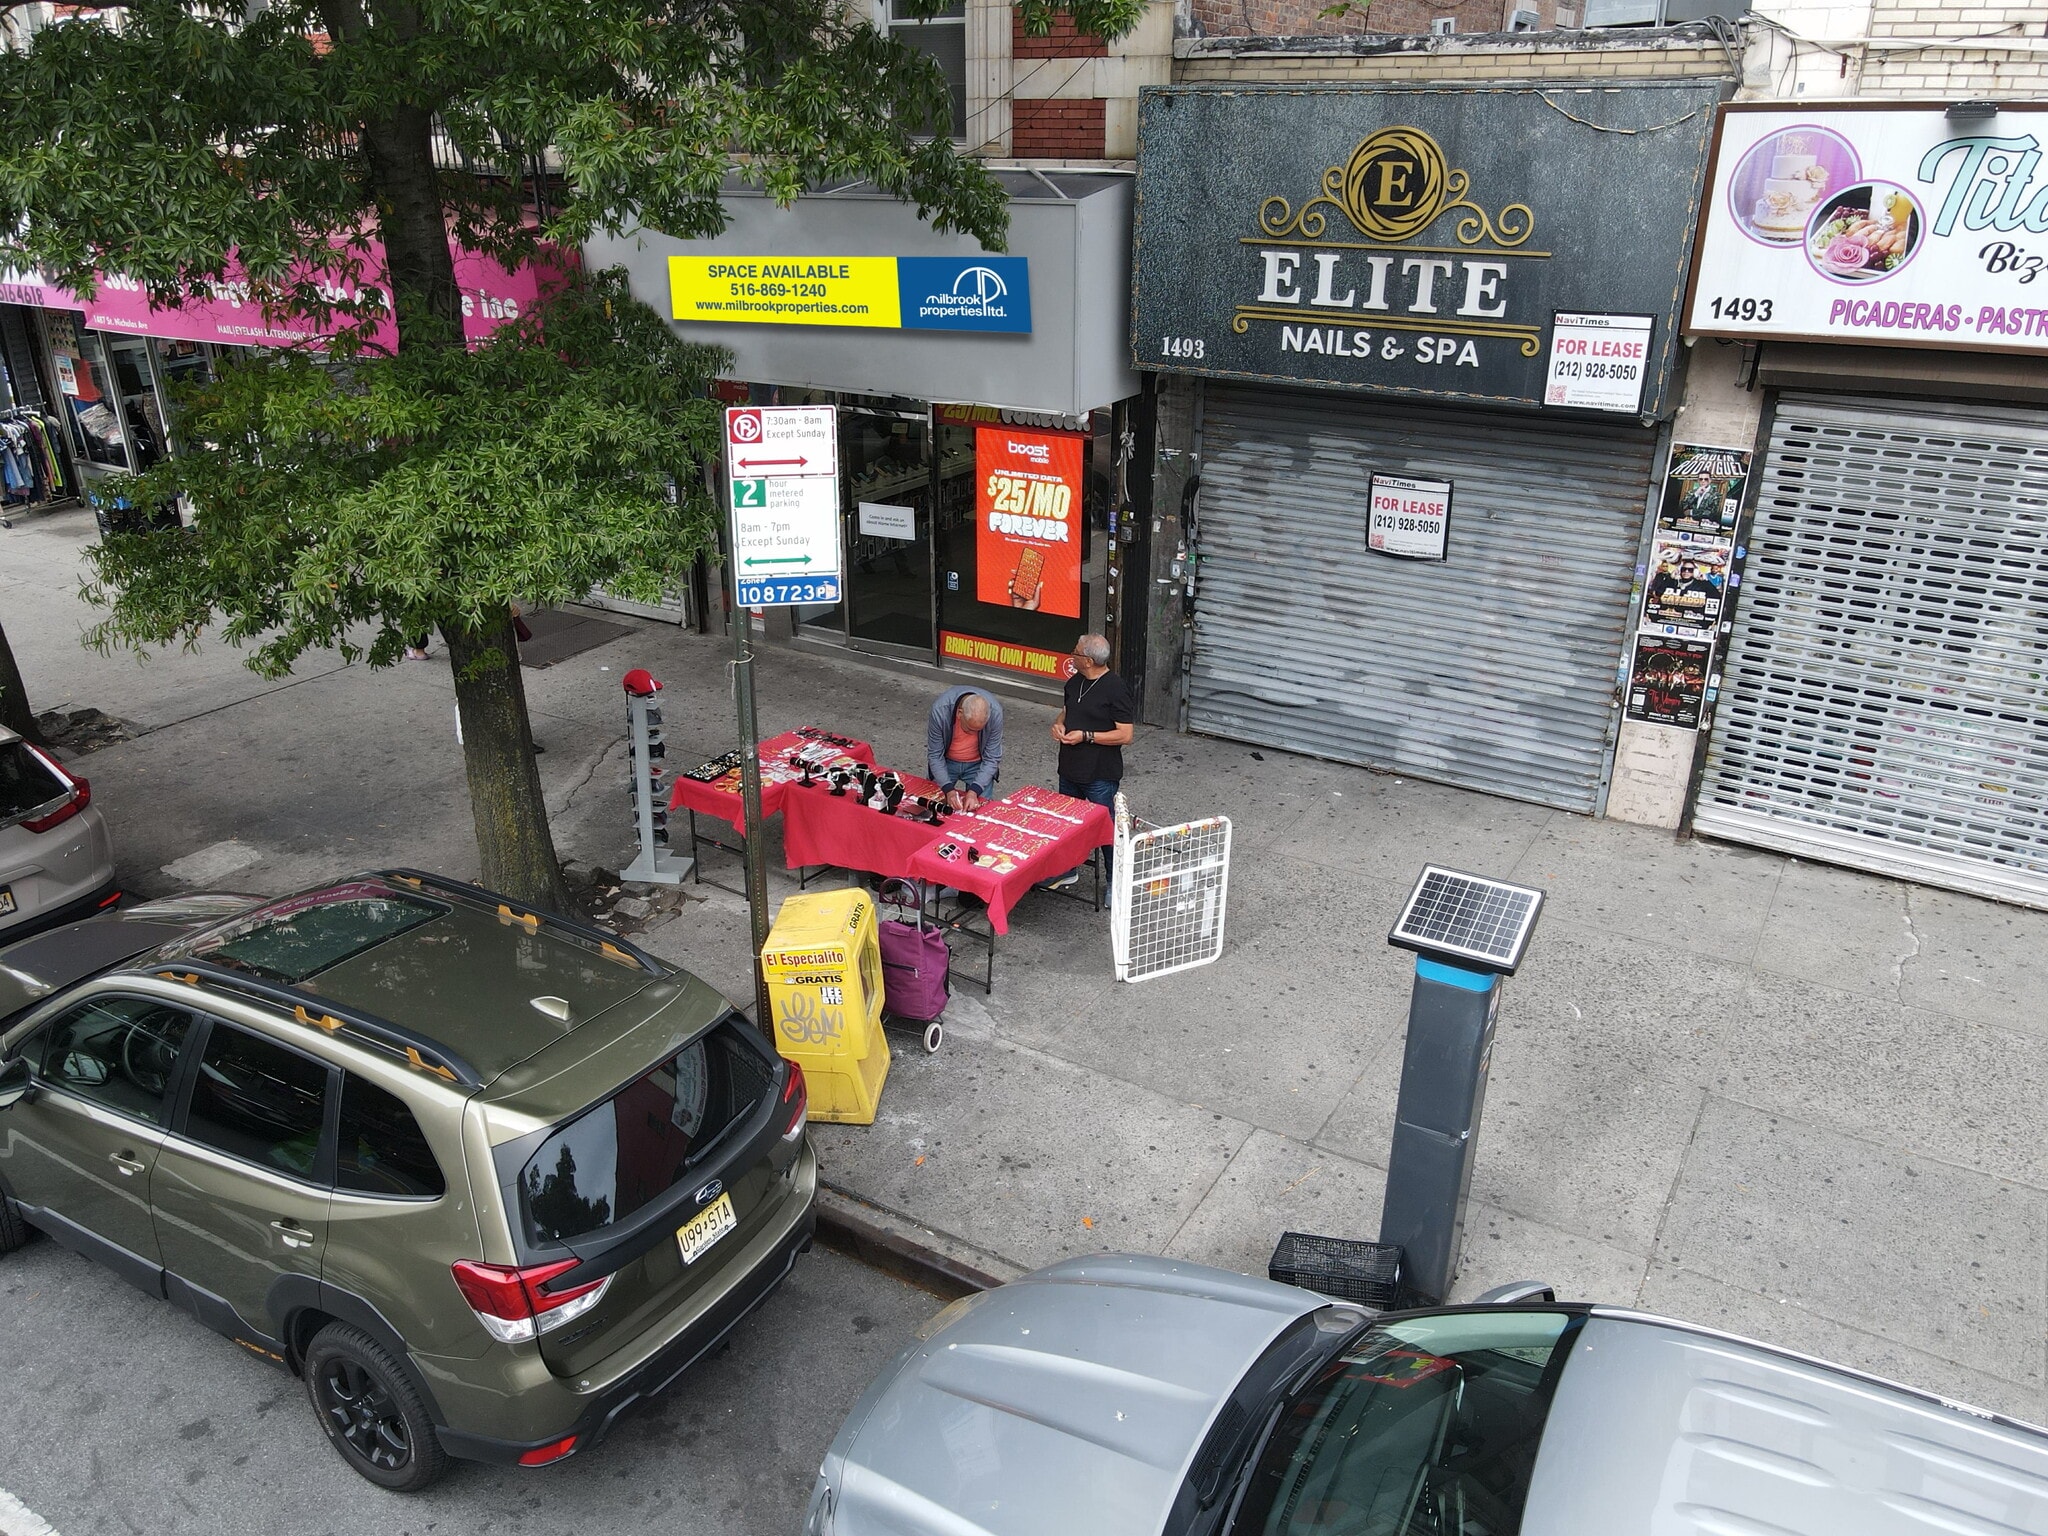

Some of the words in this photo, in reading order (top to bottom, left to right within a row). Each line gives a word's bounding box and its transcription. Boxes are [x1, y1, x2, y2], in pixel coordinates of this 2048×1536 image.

[708, 264, 758, 278] SPACE
[762, 265, 850, 279] AVAILABLE
[1978, 241, 2048, 285] Biz
[730, 283, 826, 298] 516-869-1240
[1257, 250, 1508, 319] ELITE
[480, 288, 518, 320] inc
[696, 300, 869, 314] www.milbrookproperties.com
[926, 294, 982, 305] milbrook
[920, 306, 982, 318] properties
[1710, 296, 1774, 322] 1493
[1829, 299, 1962, 332] PICADERAS
[114, 317, 138, 328] Nicholas
[1555, 316, 1610, 326] NaviTimes
[1161, 336, 1204, 359] 1493
[1281, 326, 1372, 358] NAILS
[1380, 336, 1404, 360] &
[1415, 336, 1480, 368] SPA
[1556, 338, 1588, 356] FOR
[1592, 340, 1643, 358] LEASE
[1554, 360, 1582, 381] (212)
[1585, 362, 1636, 380] 928-5050
[766, 416, 796, 426] 7:30am
[804, 416, 822, 425] 8am
[766, 430, 794, 440] Except
[796, 429, 826, 439] Sunday
[1008, 440, 1050, 458] boost
[1690, 453, 1734, 462] RAULIN
[994, 468, 1040, 480] UNLIMITED
[1040, 475, 1063, 483] DATA
[1669, 460, 1746, 476] RODRIGUEZ
[769, 480, 787, 488] hour
[1374, 477, 1416, 488] NaviTimes
[741, 480, 758, 506] 2
[770, 488, 804, 498] metered
[987, 475, 1072, 520] $25/MO
[770, 498, 800, 509] parking
[1374, 496, 1399, 512] FOR
[1402, 500, 1444, 516] LEASE
[740, 522, 761, 533] 8am
[770, 522, 790, 533] 7pm
[988, 511, 1069, 543] FOREVER
[1374, 514, 1396, 532] (212)
[1398, 517, 1440, 534] 928-5050
[741, 536, 773, 548] Except
[776, 535, 810, 546] Sunday
[741, 584, 814, 604] 108723
[945, 635, 974, 656] BRING
[974, 641, 1000, 662] YOUR
[1000, 647, 1024, 668] OWN
[1025, 652, 1058, 674] PHONE
[850, 902, 864, 929] GRATIS
[766, 954, 778, 966] El
[780, 950, 844, 968] Especialito
[796, 975, 842, 984] GRATIS
